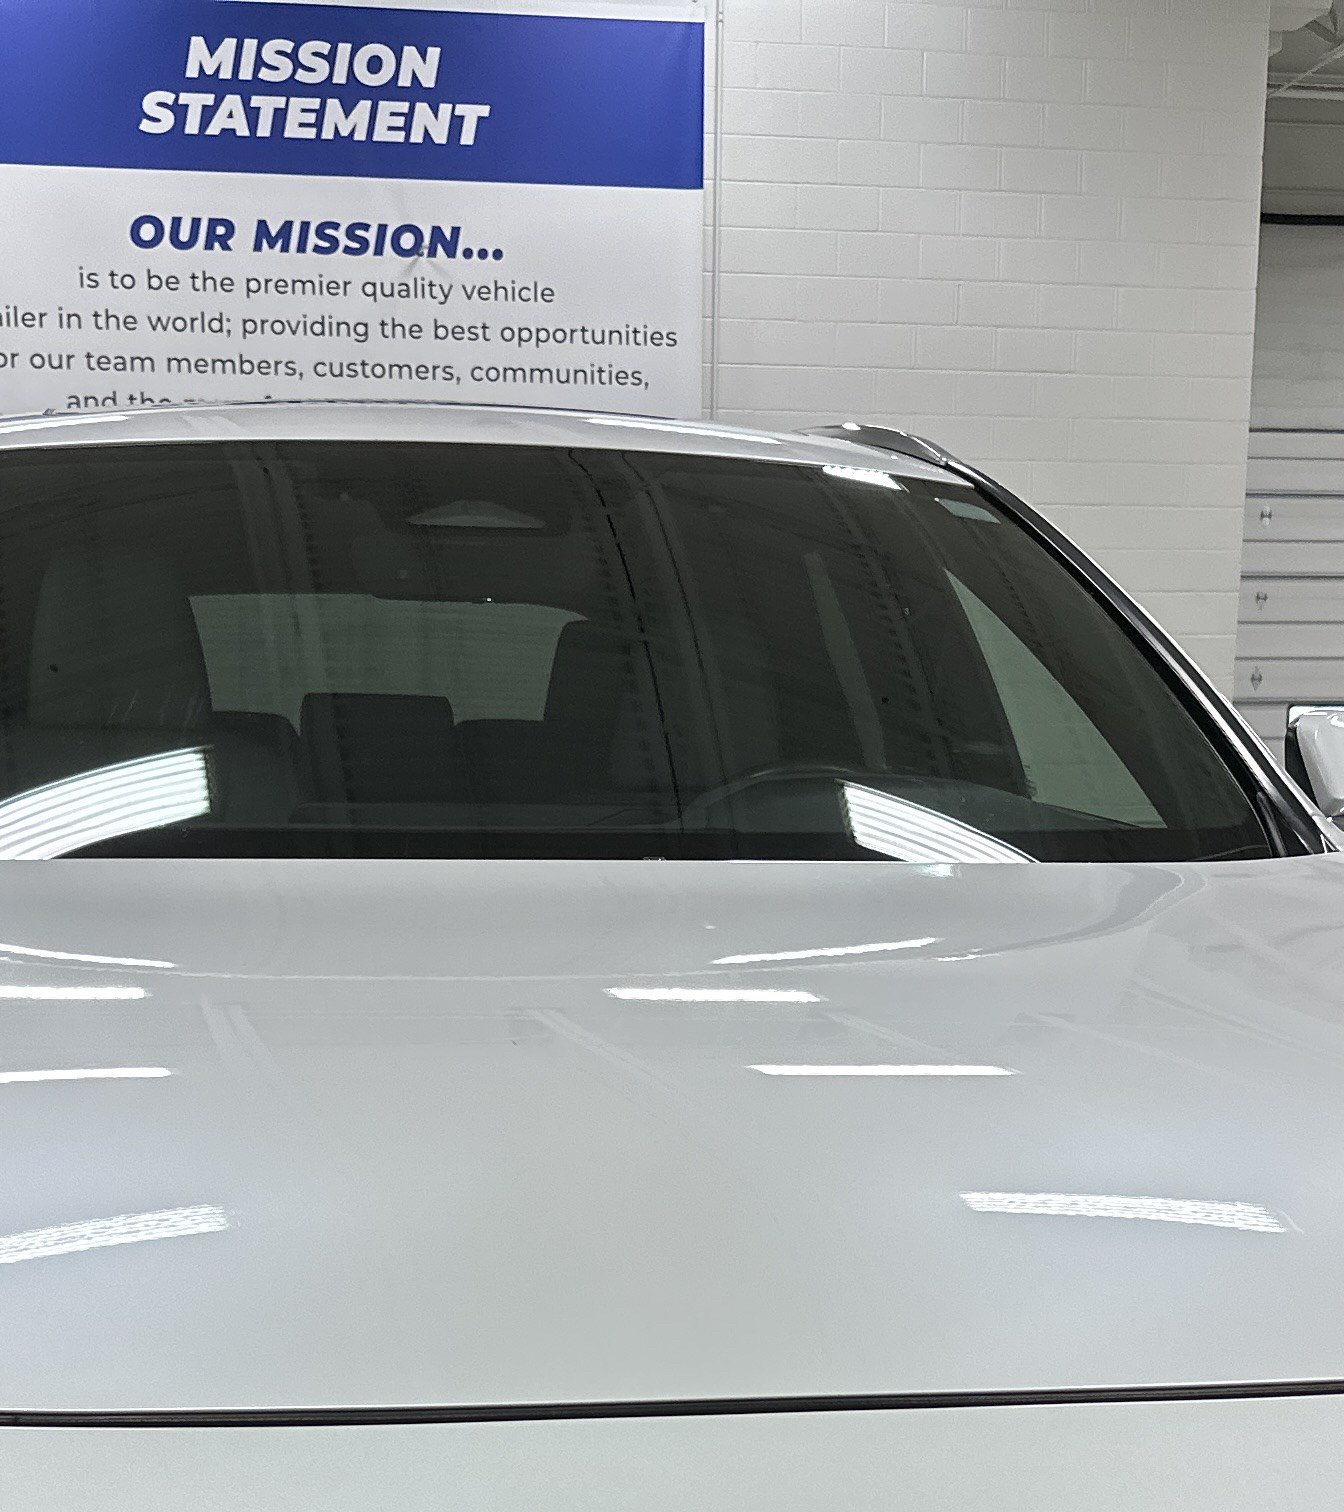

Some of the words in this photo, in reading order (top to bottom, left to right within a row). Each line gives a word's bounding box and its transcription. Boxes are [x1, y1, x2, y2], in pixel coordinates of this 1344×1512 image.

[185, 35, 442, 88] MISSION
[138, 90, 491, 146] STATEMENT
[129, 214, 236, 252] OUR
[252, 218, 504, 260] MISSION...
[78, 265, 100, 289] is
[107, 269, 136, 290] to
[146, 268, 181, 292] be
[188, 270, 235, 293] the
[245, 273, 353, 299] premier
[360, 276, 454, 305] quality
[461, 279, 556, 304] vehicle
[57, 306, 83, 330] in
[91, 307, 139, 332] the
[146, 311, 232, 338] world;
[241, 314, 370, 344] providing
[378, 316, 424, 340] the
[433, 318, 492, 342] best
[500, 323, 678, 349] opportunities
[29, 352, 76, 371] our
[84, 351, 156, 373] team
[166, 353, 304, 381] members,
[313, 359, 462, 385] customers,
[470, 362, 649, 389] communities,
[67, 389, 117, 409] and
